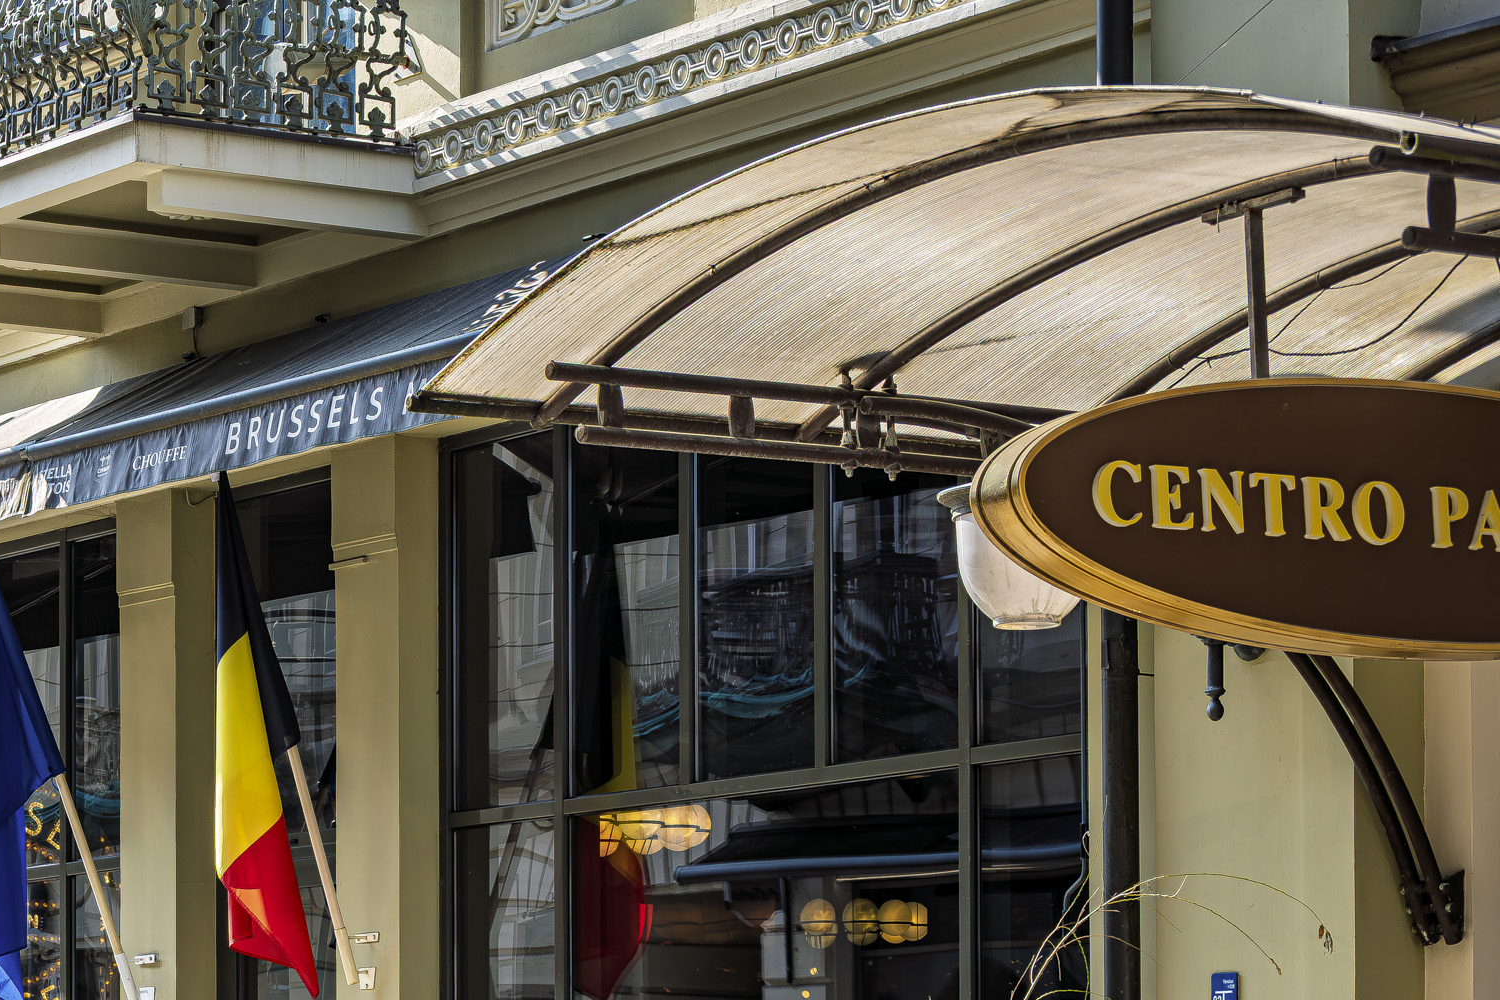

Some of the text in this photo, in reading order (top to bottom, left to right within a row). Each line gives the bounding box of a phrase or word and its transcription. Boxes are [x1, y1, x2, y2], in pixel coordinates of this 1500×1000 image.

[225, 387, 384, 455] BRUSSELS
[132, 445, 187, 471] CHOUFFE
[1092, 460, 1405, 546] CENTRO
